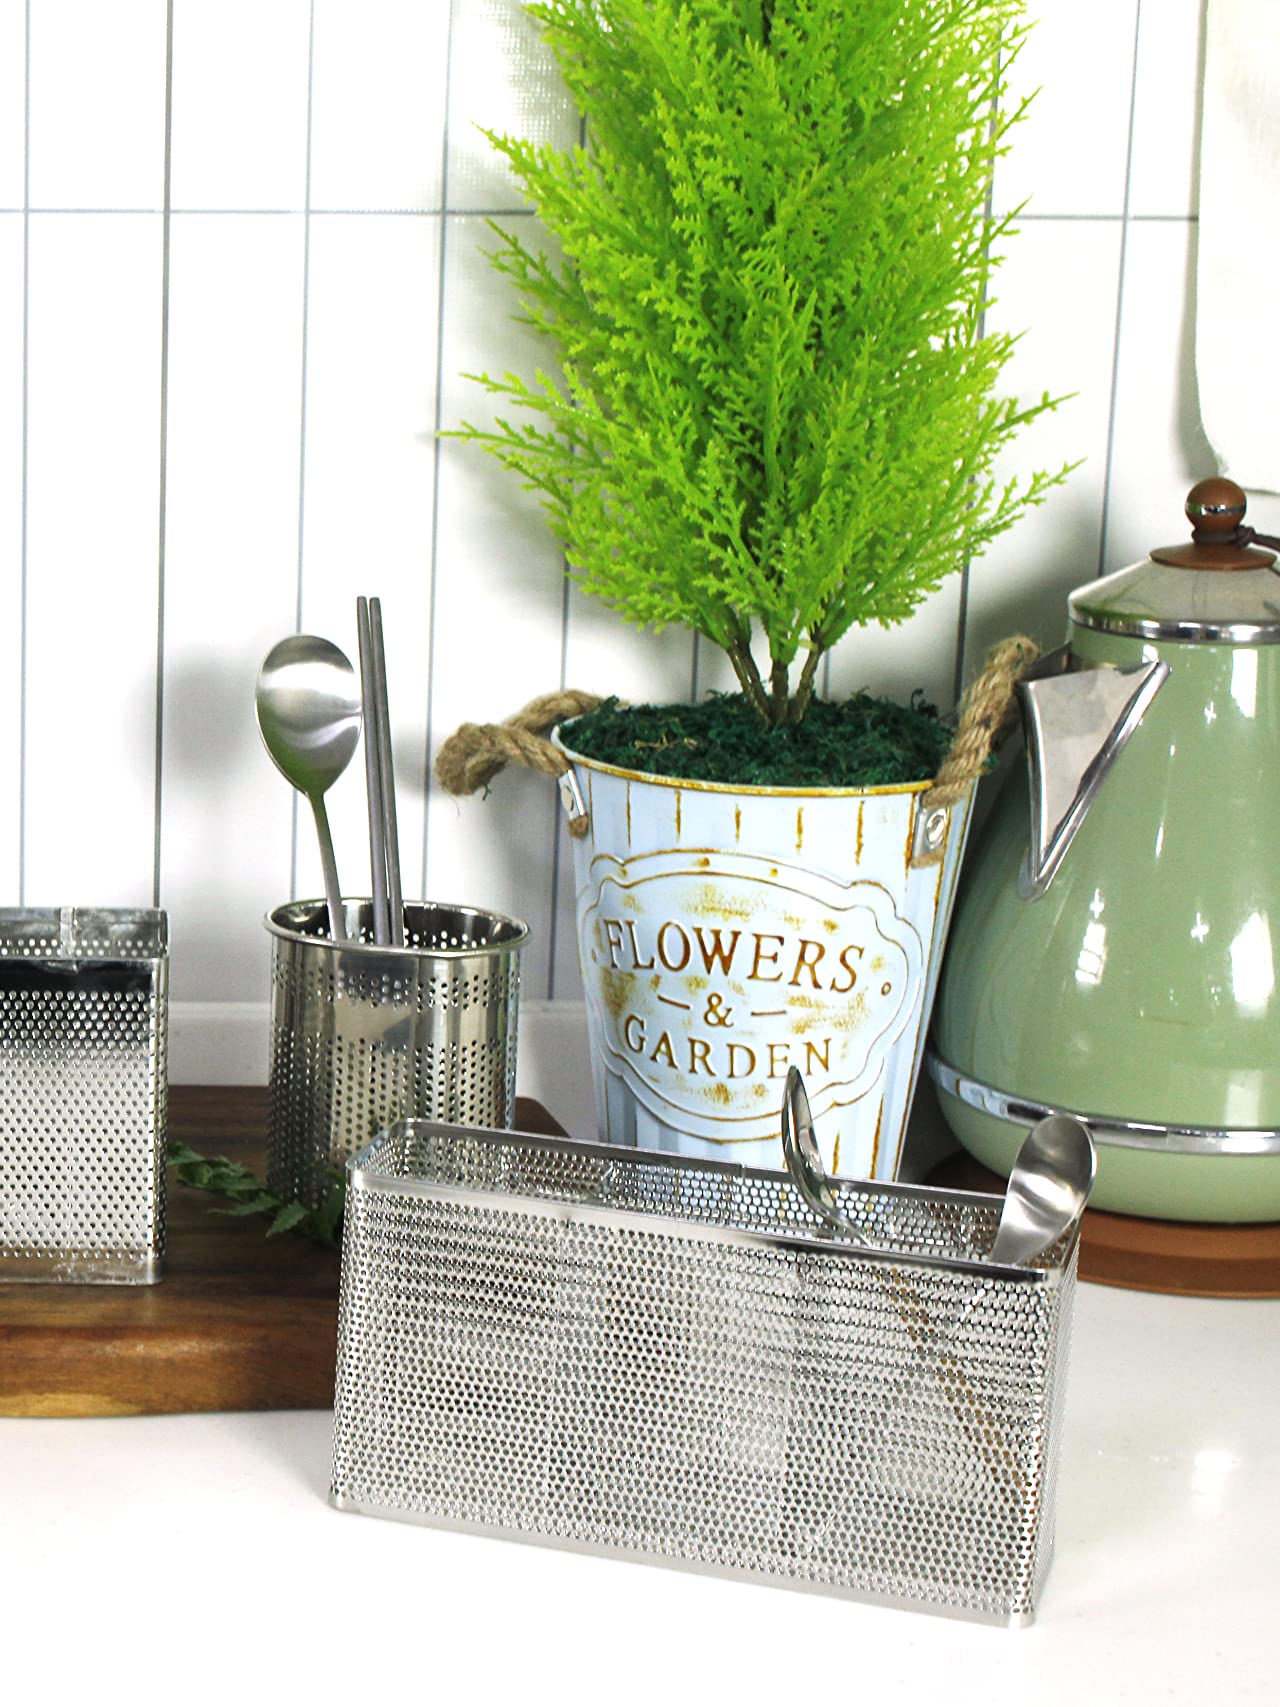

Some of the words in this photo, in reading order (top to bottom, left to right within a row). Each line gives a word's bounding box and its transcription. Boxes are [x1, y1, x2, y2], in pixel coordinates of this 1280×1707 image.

[603, 919, 864, 993] FLOWERS
[703, 992, 734, 1028] &
[624, 1014, 832, 1079] GARDEN
